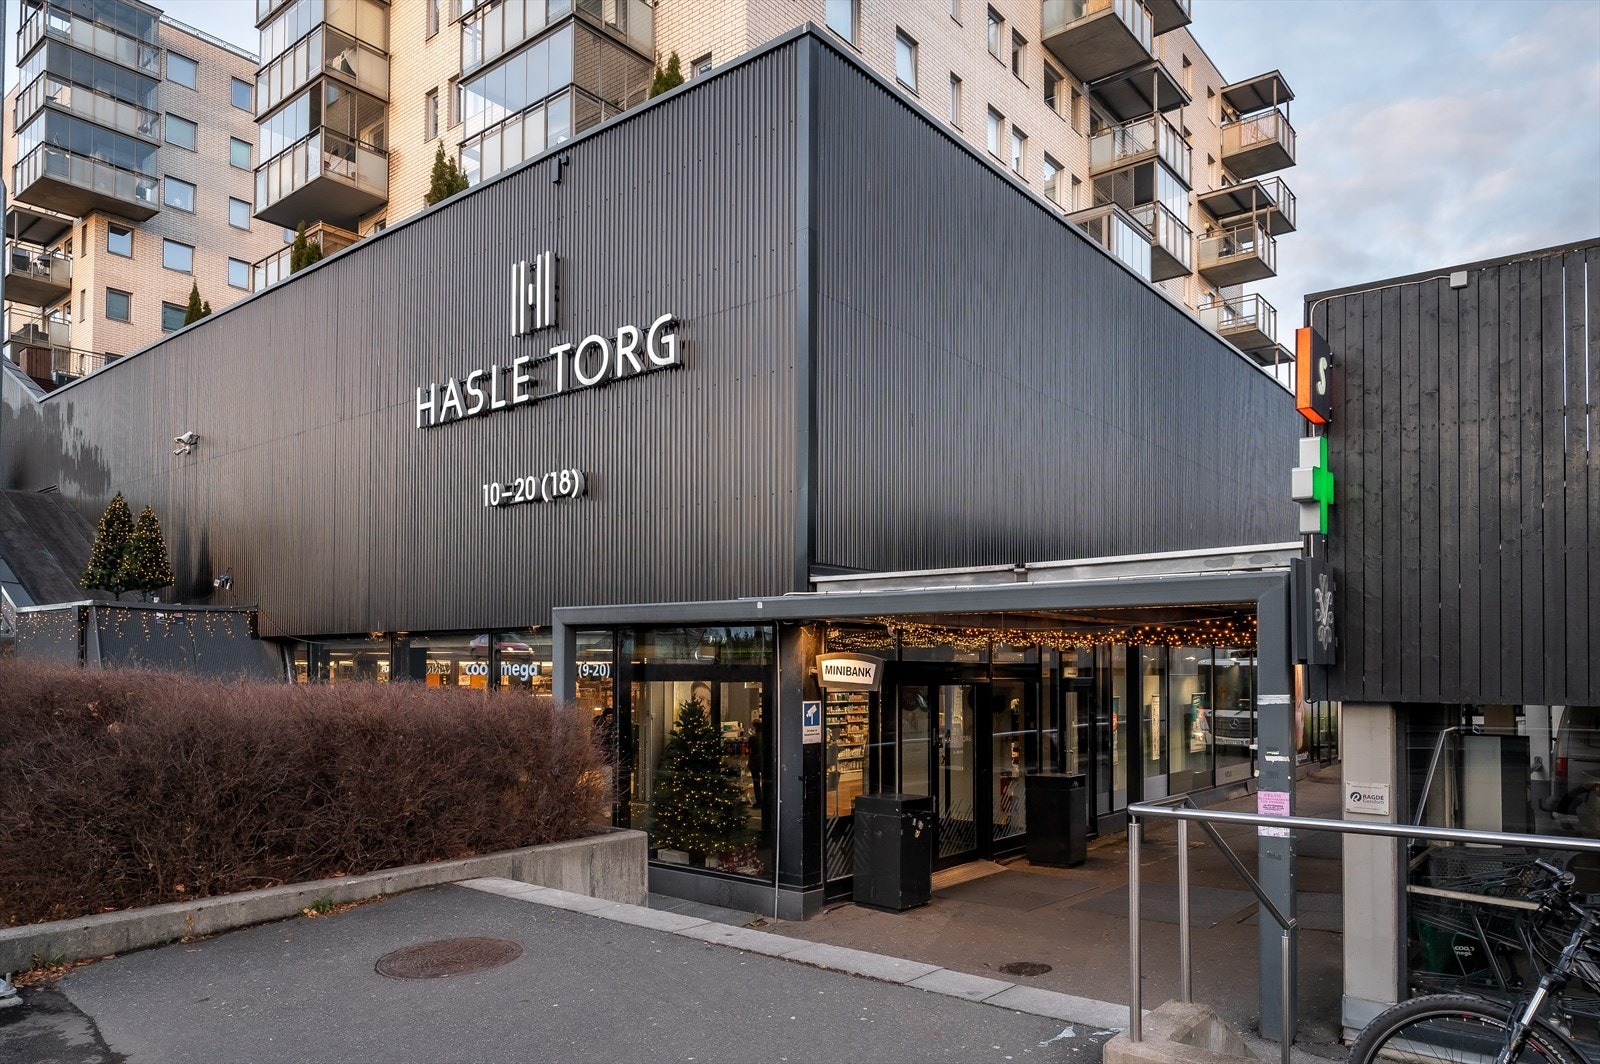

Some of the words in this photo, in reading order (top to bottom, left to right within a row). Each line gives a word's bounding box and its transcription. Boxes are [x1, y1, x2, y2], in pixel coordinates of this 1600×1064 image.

[416, 355, 531, 429] HASLE
[549, 313, 677, 392] TORG
[1317, 357, 1328, 395] S
[541, 468, 580, 502] (18)
[465, 663, 489, 676] coo
[501, 663, 538, 682] mega
[578, 663, 610, 679] (9-20)
[824, 665, 872, 678] MINIBANK
